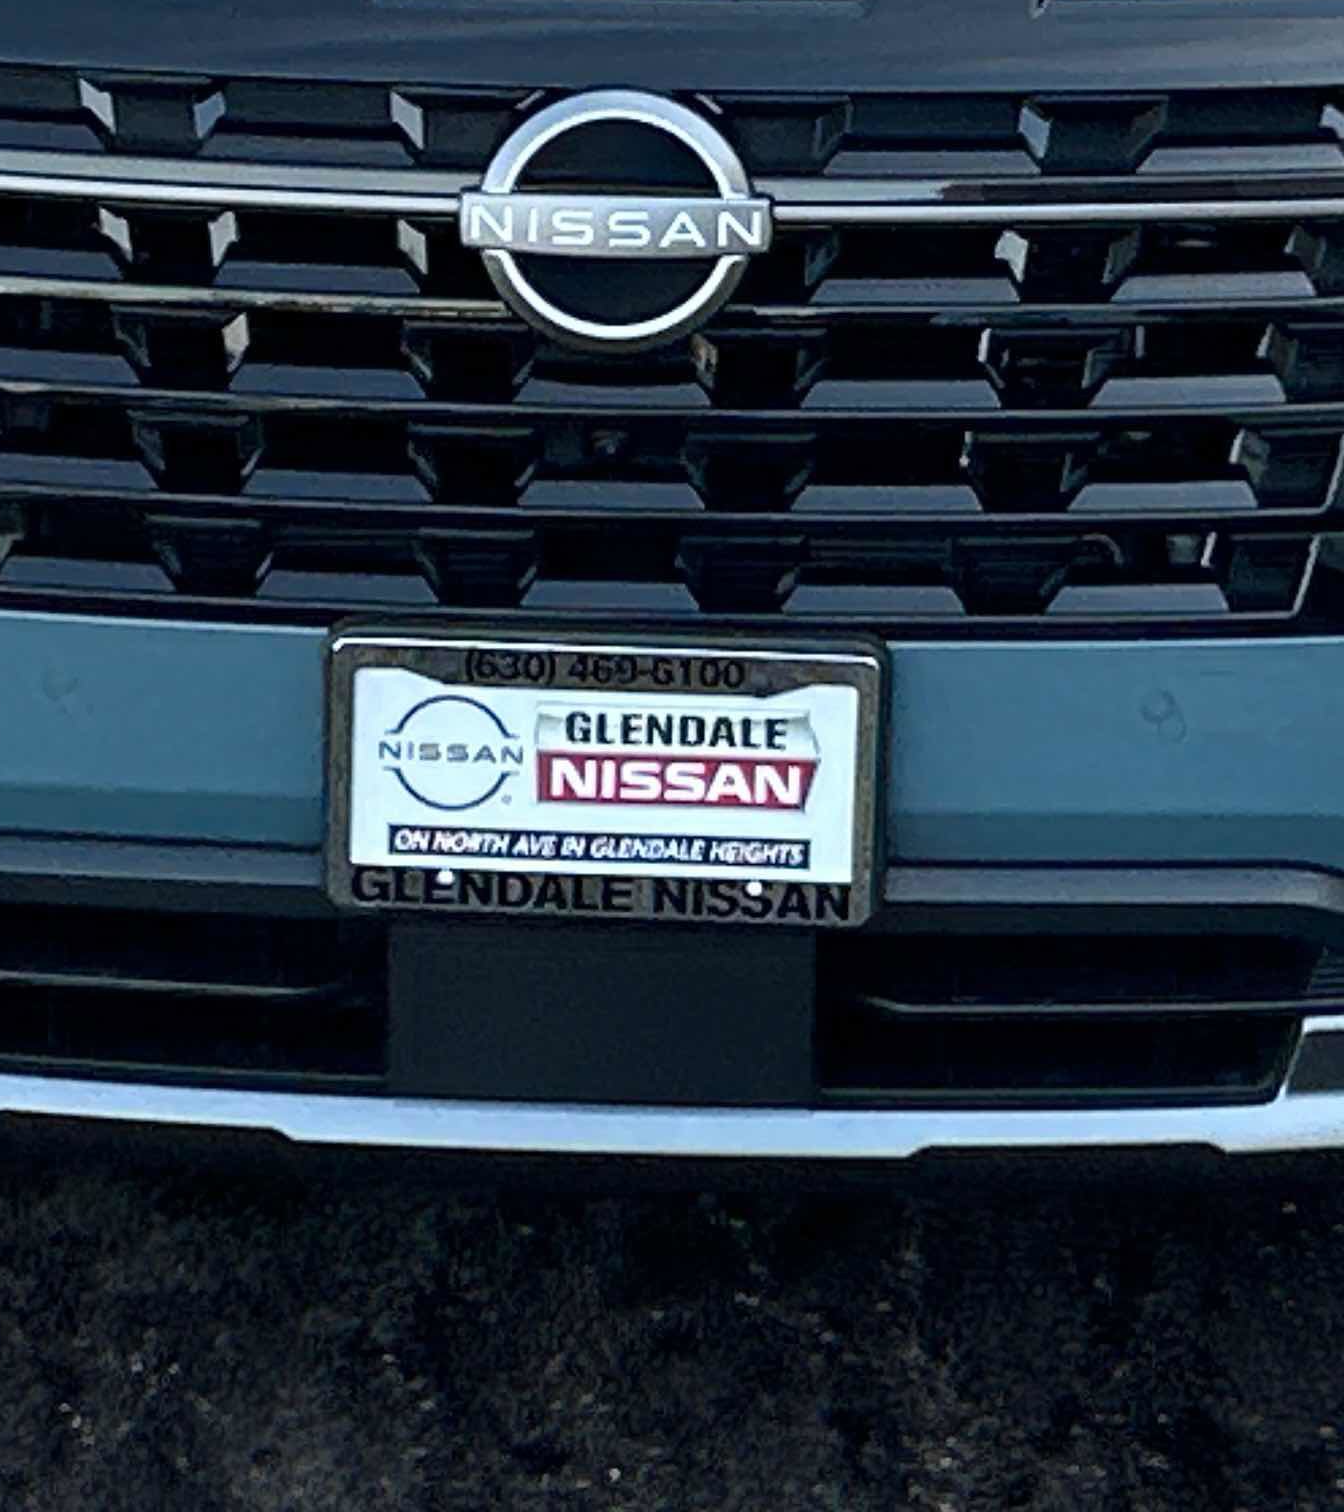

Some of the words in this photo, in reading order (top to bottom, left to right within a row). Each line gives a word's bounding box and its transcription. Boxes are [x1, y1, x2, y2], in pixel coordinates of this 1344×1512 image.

[469, 205, 763, 249] NISSAN
[465, 648, 555, 685] (630)
[564, 711, 788, 751] GLENDALE
[378, 740, 524, 765] NISSAN
[550, 756, 802, 806] NISSAN
[394, 828, 431, 851] ON
[432, 830, 511, 855] NORTH
[511, 833, 558, 857] AVE
[560, 835, 587, 859] IN
[590, 836, 706, 862] GLENDALE
[709, 840, 806, 866] HEIGHTS
[352, 866, 636, 913] GLENDALE
[652, 877, 851, 921] NISSAN
